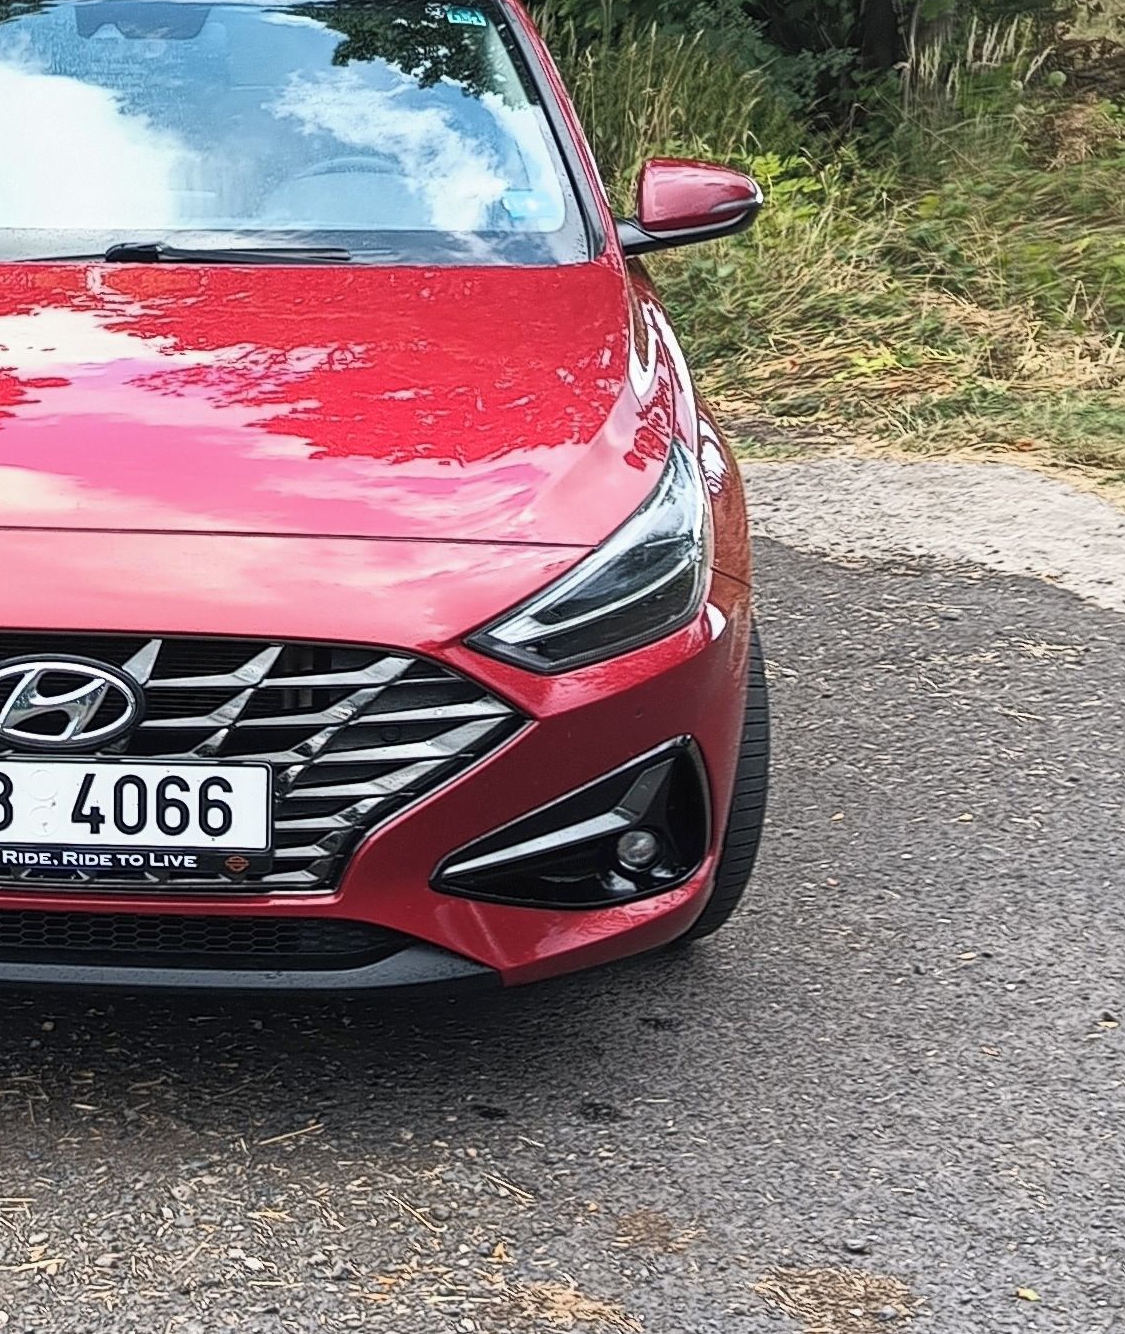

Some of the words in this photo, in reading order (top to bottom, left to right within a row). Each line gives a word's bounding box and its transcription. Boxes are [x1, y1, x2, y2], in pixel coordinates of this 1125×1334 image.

[71, 773, 233, 837] 4066
[2, 849, 59, 866] RIDE,
[62, 851, 113, 866] RIDE
[116, 854, 144, 867] TO
[149, 852, 198, 868] LIVE
